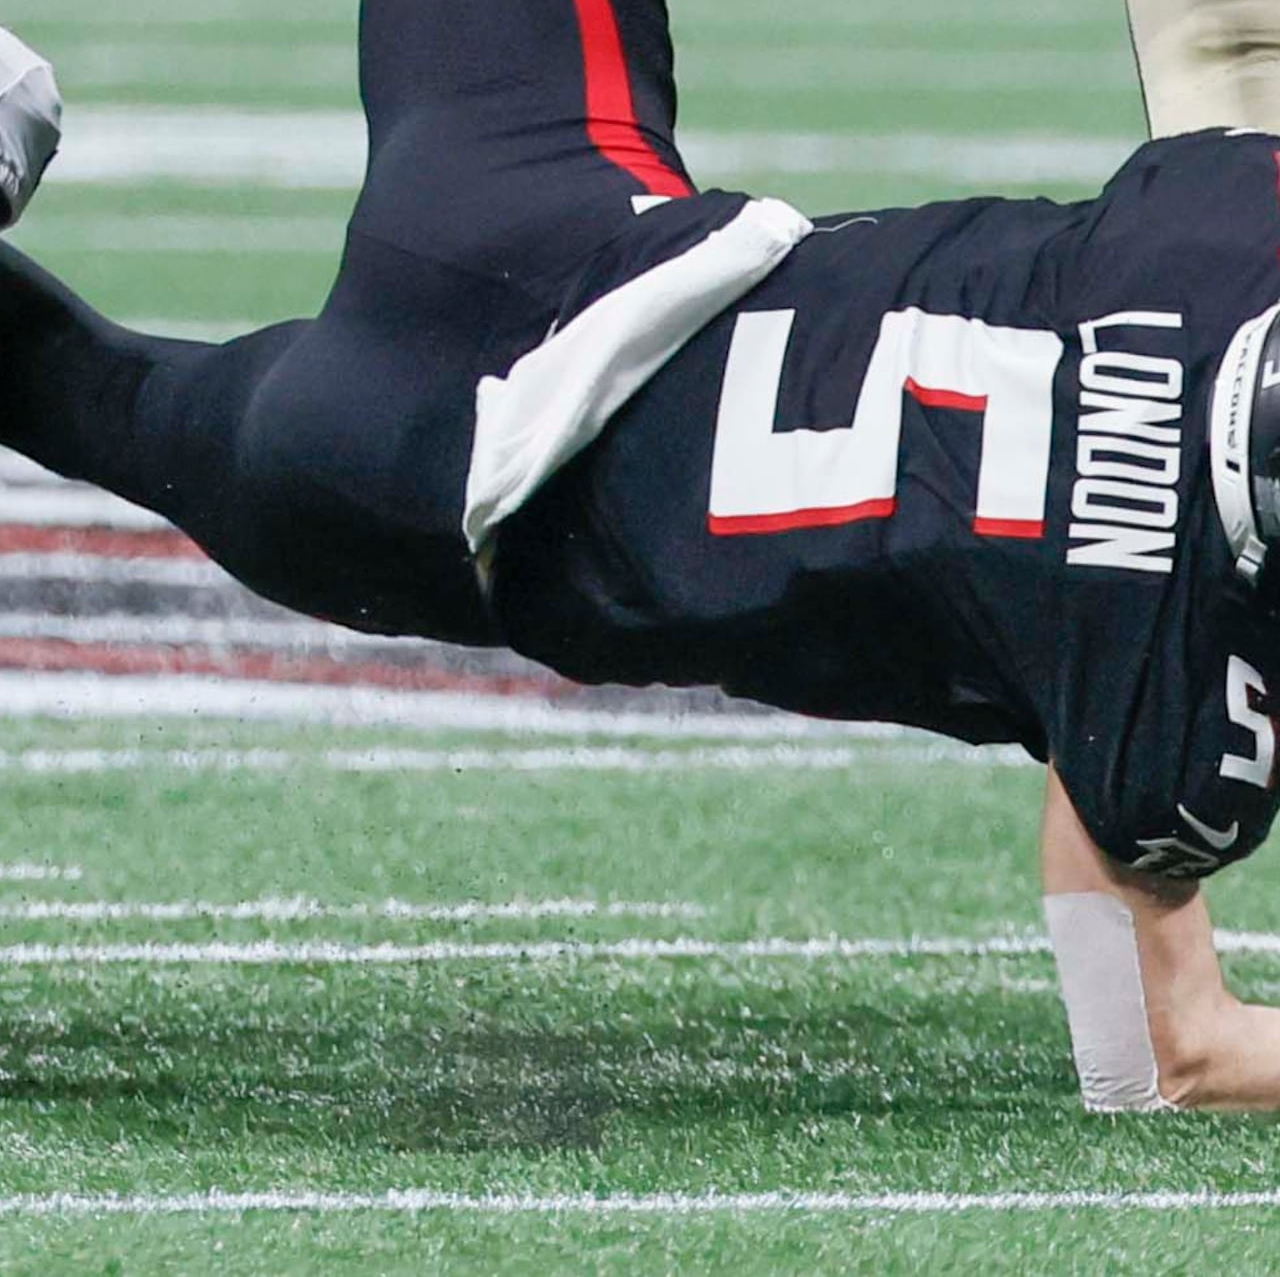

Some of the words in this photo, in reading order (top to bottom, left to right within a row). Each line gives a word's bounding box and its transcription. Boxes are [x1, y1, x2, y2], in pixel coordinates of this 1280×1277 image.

[708, 305, 1065, 536] 5
[1065, 310, 1183, 574] LONDON
[1220, 653, 1278, 788] 5
